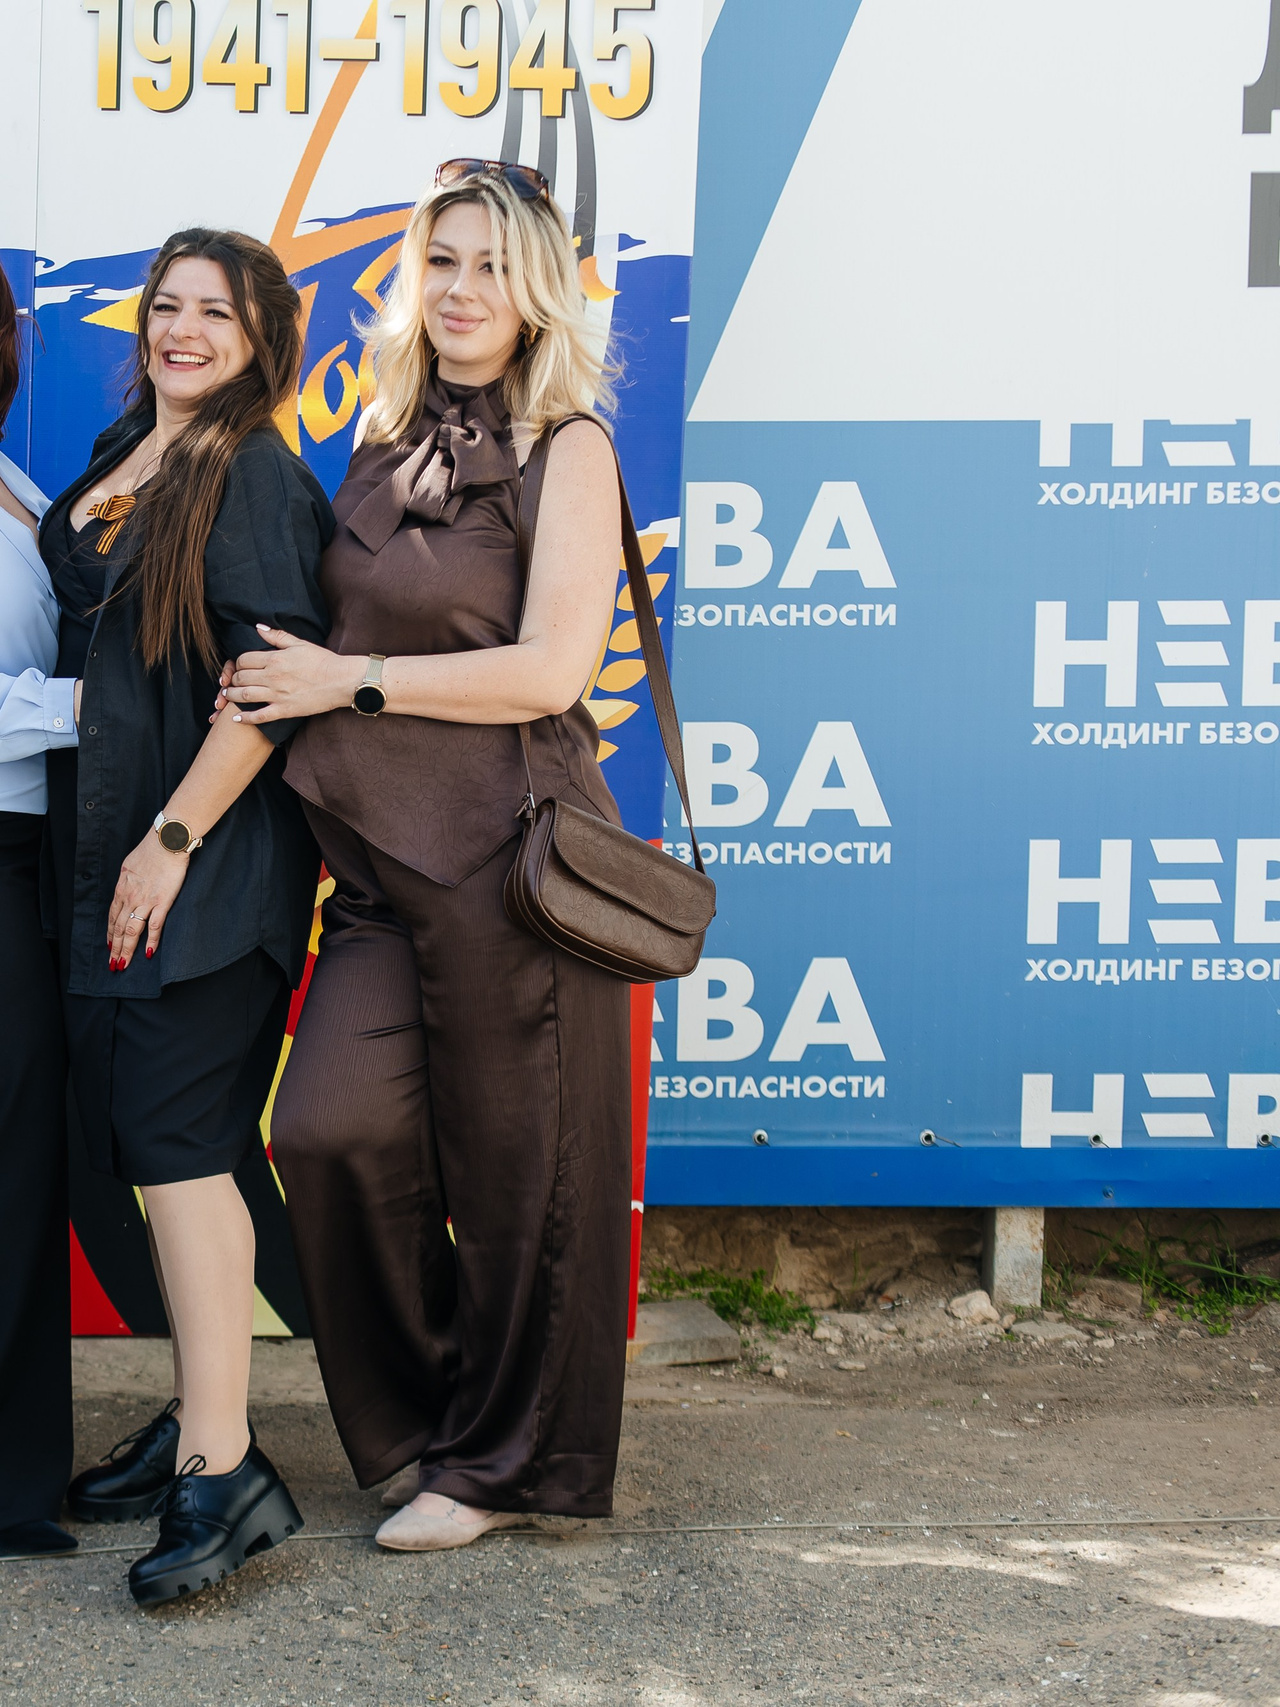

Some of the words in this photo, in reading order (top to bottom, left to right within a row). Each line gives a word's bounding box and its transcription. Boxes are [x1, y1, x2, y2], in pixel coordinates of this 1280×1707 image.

[1037, 482, 1199, 509] ХОЛДИНГ
[1207, 481, 1280, 505] БЕЗО
[674, 604, 897, 627] ЗОПАСНОСТИ
[1031, 722, 1191, 749] ХОЛДИНГ
[1200, 722, 1280, 745] БЕЗО
[663, 721, 892, 828] ВА
[1025, 959, 1184, 985] ХОЛДИНГ
[651, 957, 887, 1062] ВА
[649, 1076, 886, 1098] ЕЗОПАСНОСТИ
